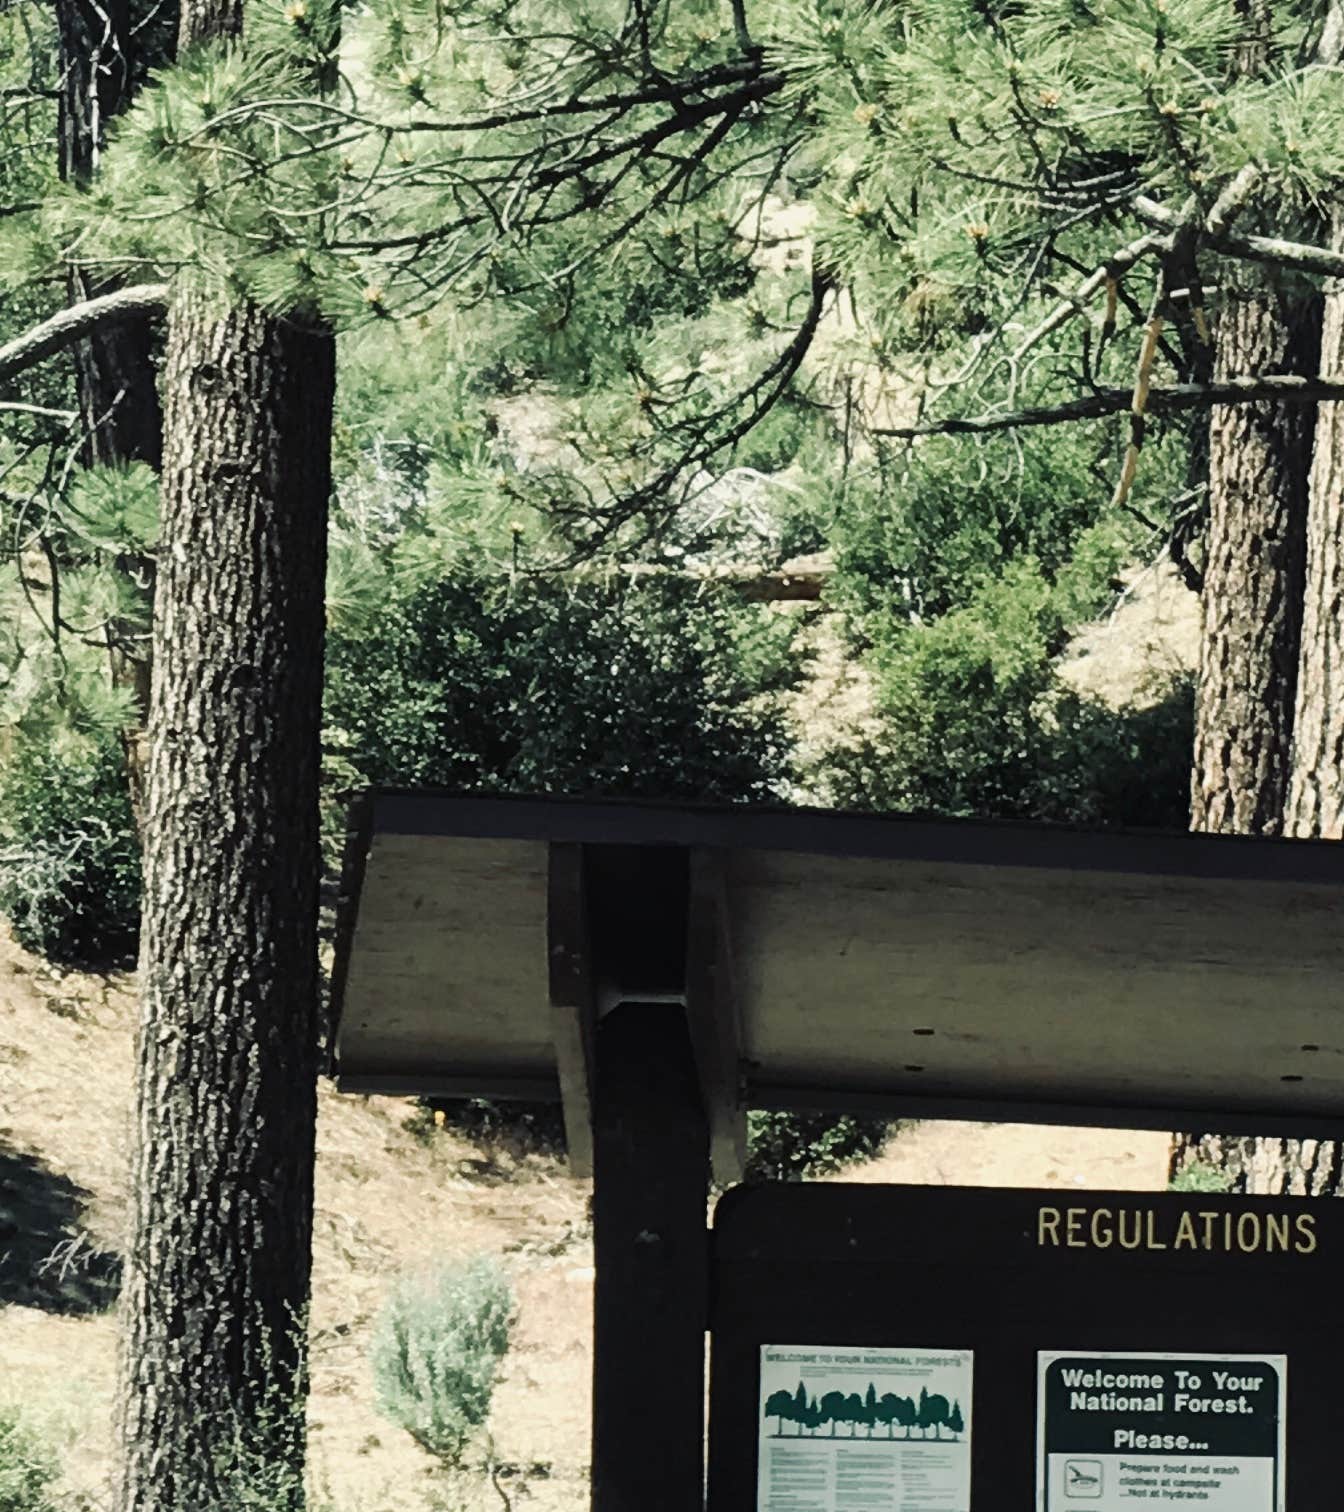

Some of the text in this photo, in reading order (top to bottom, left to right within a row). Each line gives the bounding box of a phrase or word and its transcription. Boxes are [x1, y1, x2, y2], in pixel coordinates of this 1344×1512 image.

[1038, 1207, 1316, 1253] REGULATIONS
[1062, 1369, 1263, 1391] Welcome To Your
[1070, 1393, 1253, 1413] National Forest.
[1114, 1430, 1209, 1449] Please...
[1163, 1463, 1186, 1474] food
[1190, 1464, 1210, 1474] and
